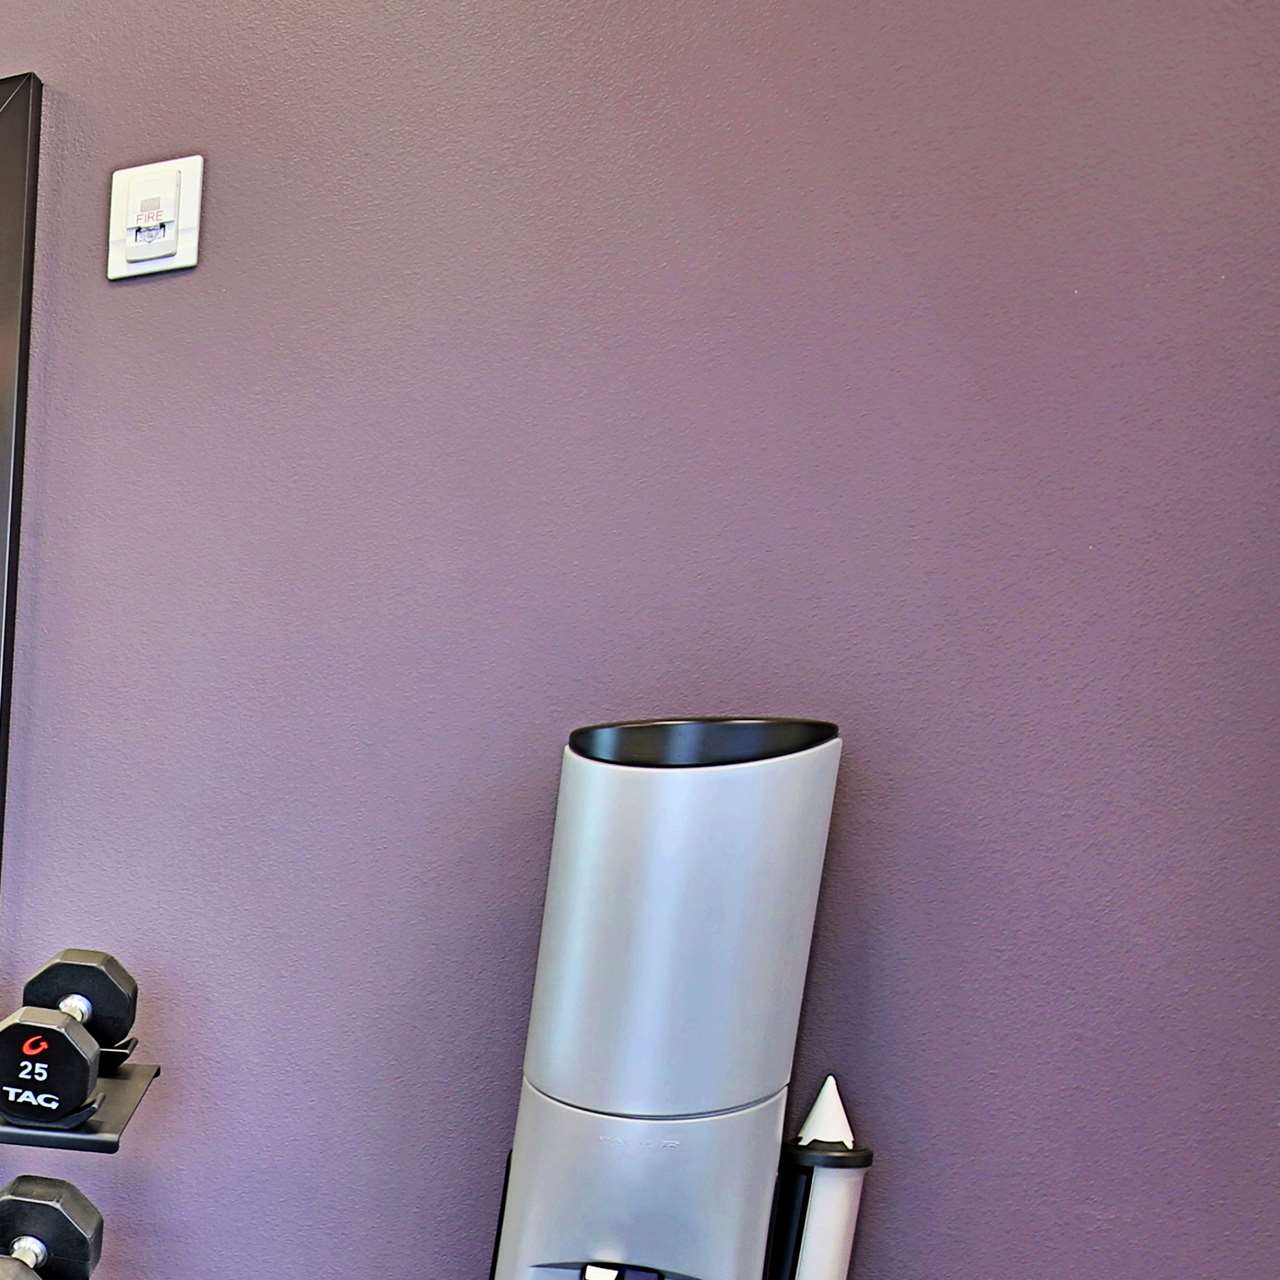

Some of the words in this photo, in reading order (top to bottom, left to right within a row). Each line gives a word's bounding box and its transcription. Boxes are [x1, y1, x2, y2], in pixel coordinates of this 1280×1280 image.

[136, 210, 164, 224] FIRE
[19, 1061, 48, 1081] 25
[3, 1087, 58, 1109] TAG
